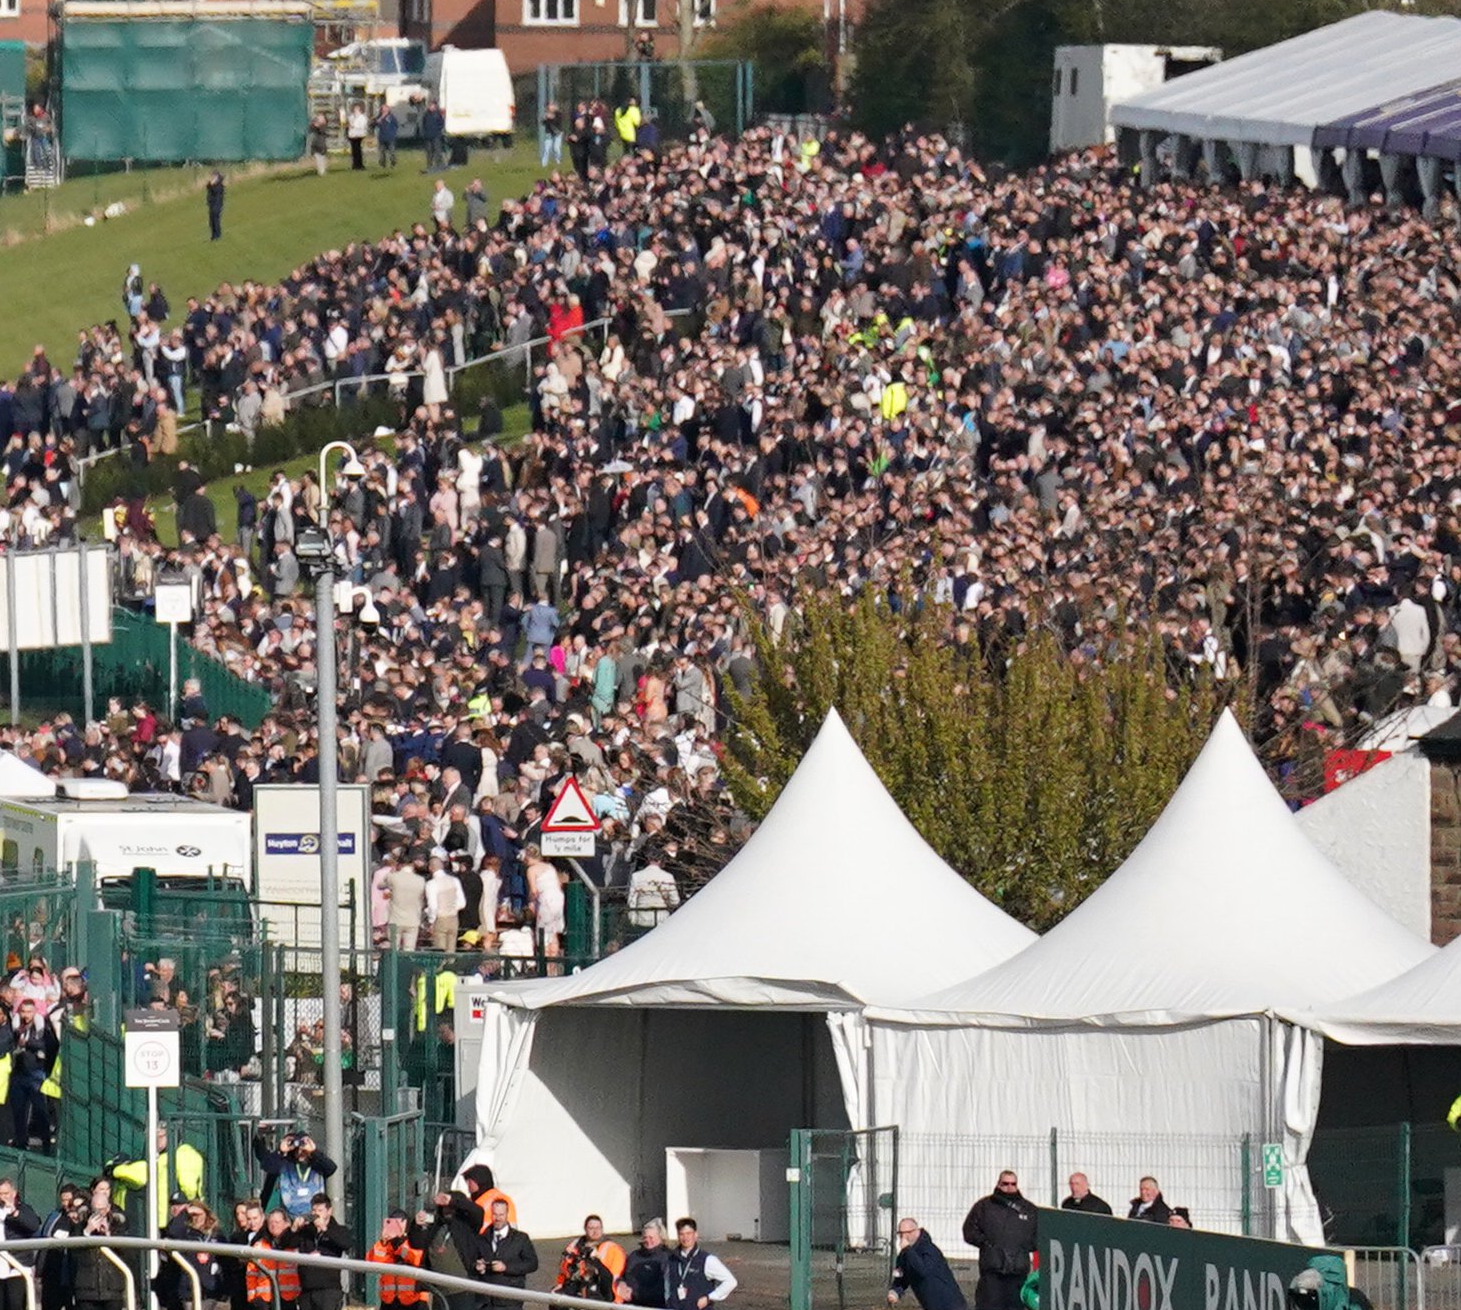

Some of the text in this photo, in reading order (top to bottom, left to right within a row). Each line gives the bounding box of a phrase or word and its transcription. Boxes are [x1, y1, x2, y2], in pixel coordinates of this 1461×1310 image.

[545, 835, 576, 843] Humps
[139, 1050, 164, 1058] STOP
[146, 1060, 159, 1070] 13
